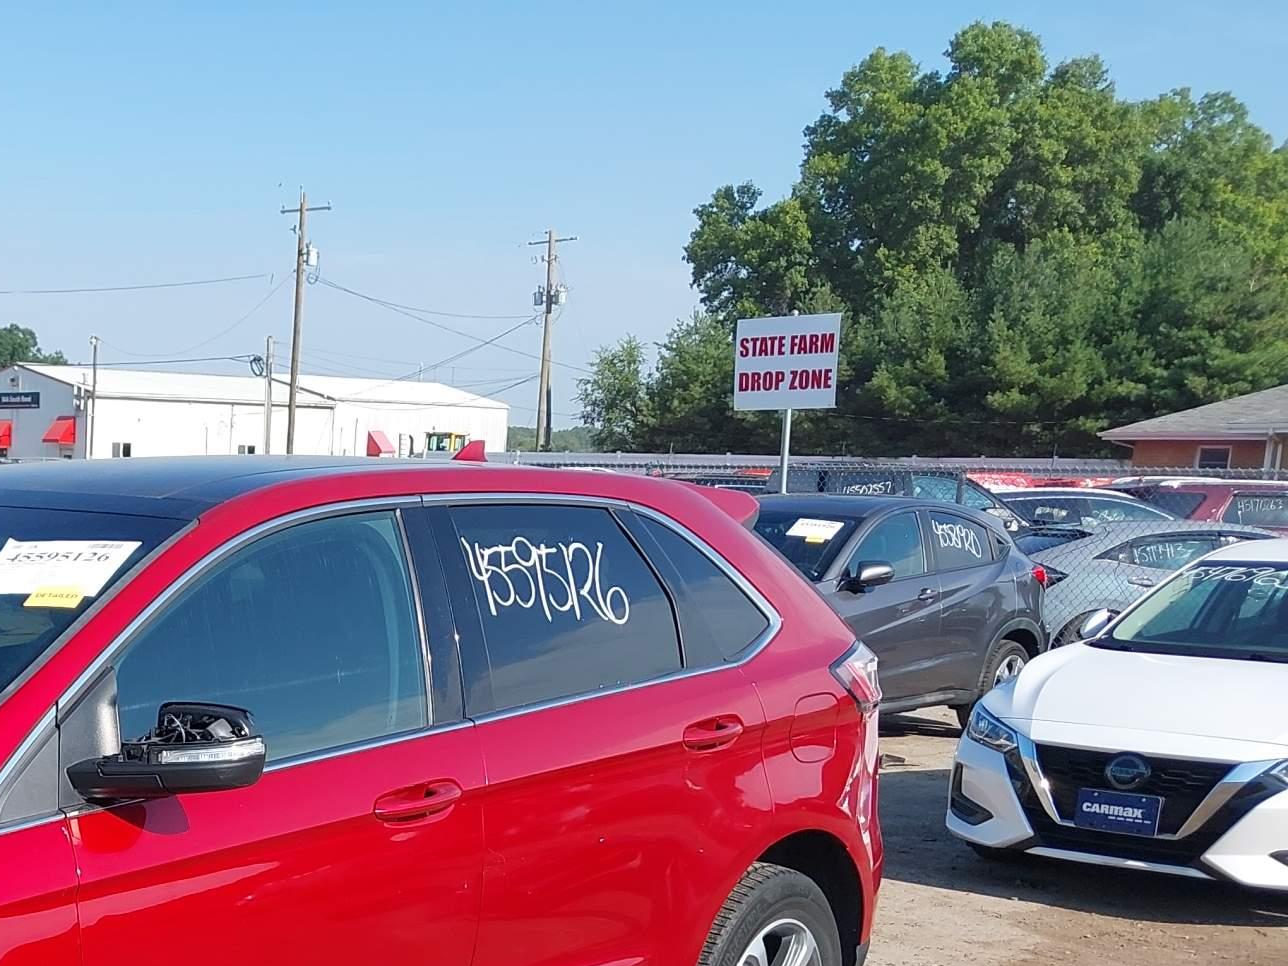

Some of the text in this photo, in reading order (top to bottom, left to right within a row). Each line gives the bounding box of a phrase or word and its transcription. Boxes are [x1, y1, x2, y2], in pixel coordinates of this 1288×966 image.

[739, 332, 835, 358] STATE FARM
[738, 368, 833, 392] DROP ZONE
[6, 551, 111, 562] 45595126
[460, 536, 630, 625] 45595126
